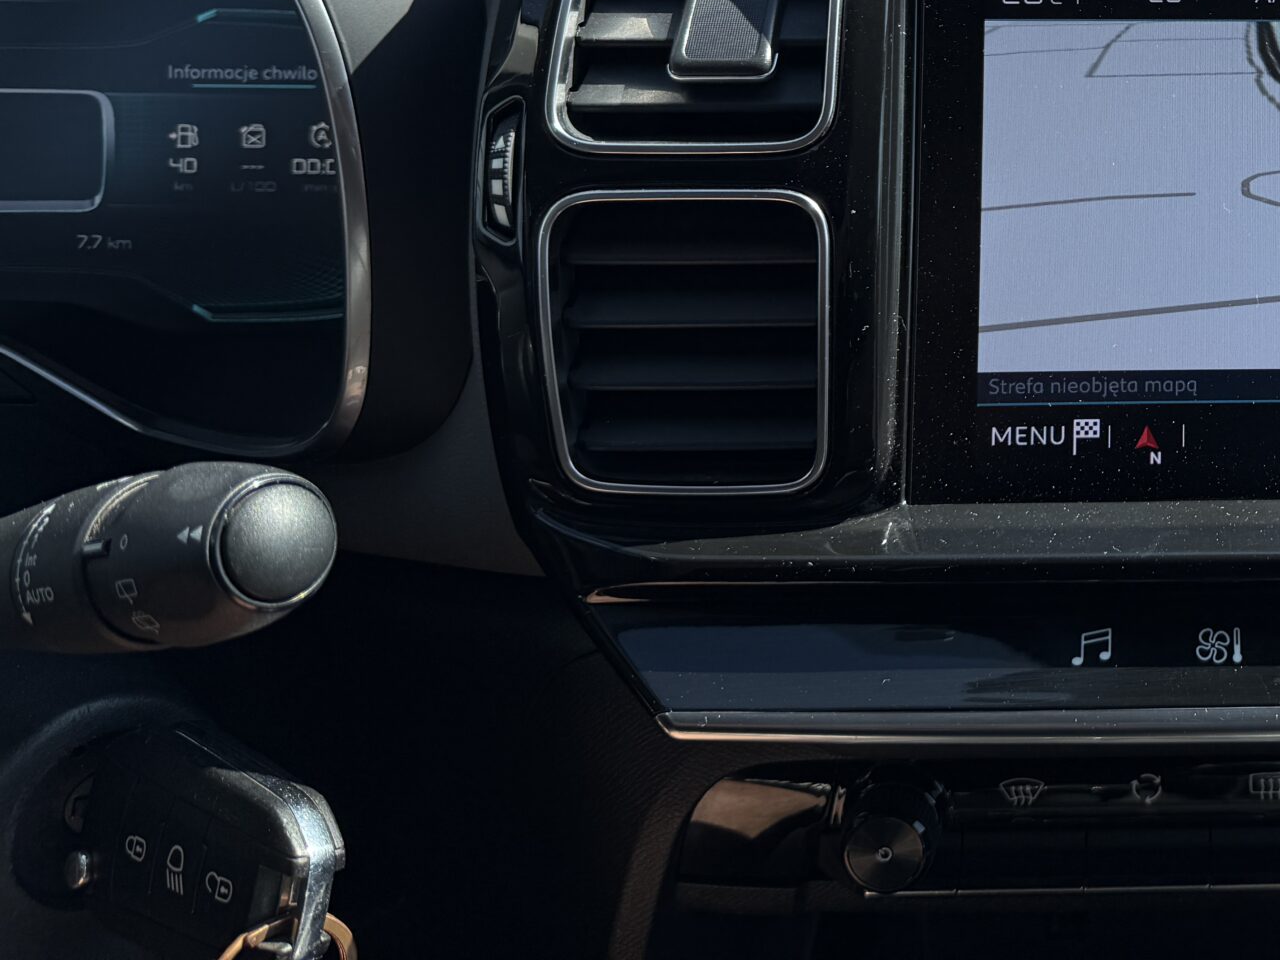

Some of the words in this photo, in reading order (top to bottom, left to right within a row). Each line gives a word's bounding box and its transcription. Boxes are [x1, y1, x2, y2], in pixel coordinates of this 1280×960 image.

[168, 65, 259, 82] Informacje
[168, 157, 198, 174] 40
[988, 377, 1044, 395] Strefa
[1050, 376, 1139, 398] nieobjęta
[1145, 379, 1198, 397] mapą
[991, 425, 1066, 447] MENU
[1150, 451, 1162, 465] N
[25, 587, 55, 604] AUTO
